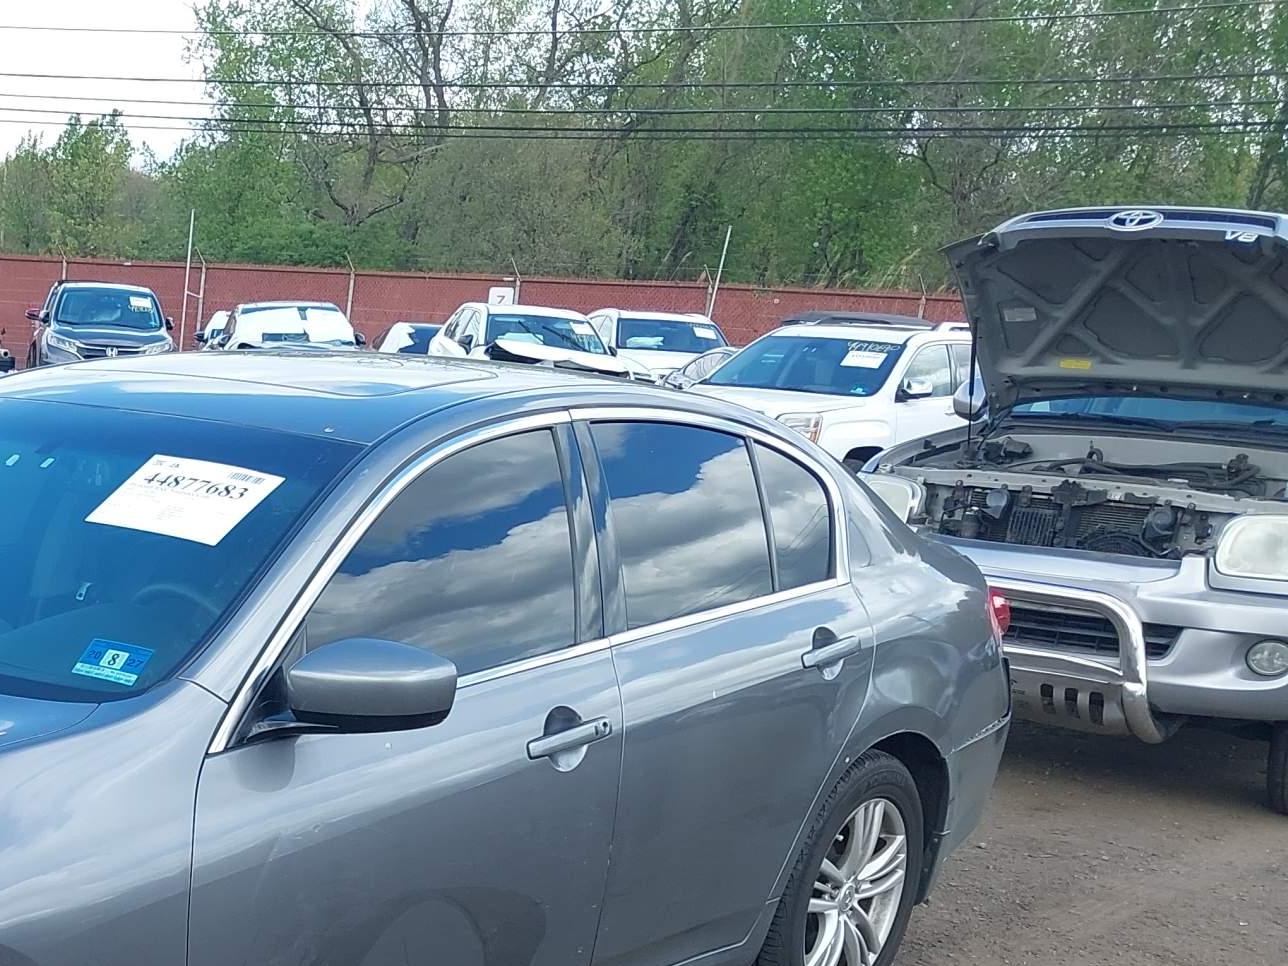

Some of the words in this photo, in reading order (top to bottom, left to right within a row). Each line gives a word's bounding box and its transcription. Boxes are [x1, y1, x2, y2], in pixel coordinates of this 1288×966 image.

[1224, 229, 1259, 243] V8
[144, 472, 248, 499] 44877683
[108, 653, 120, 666] 8
